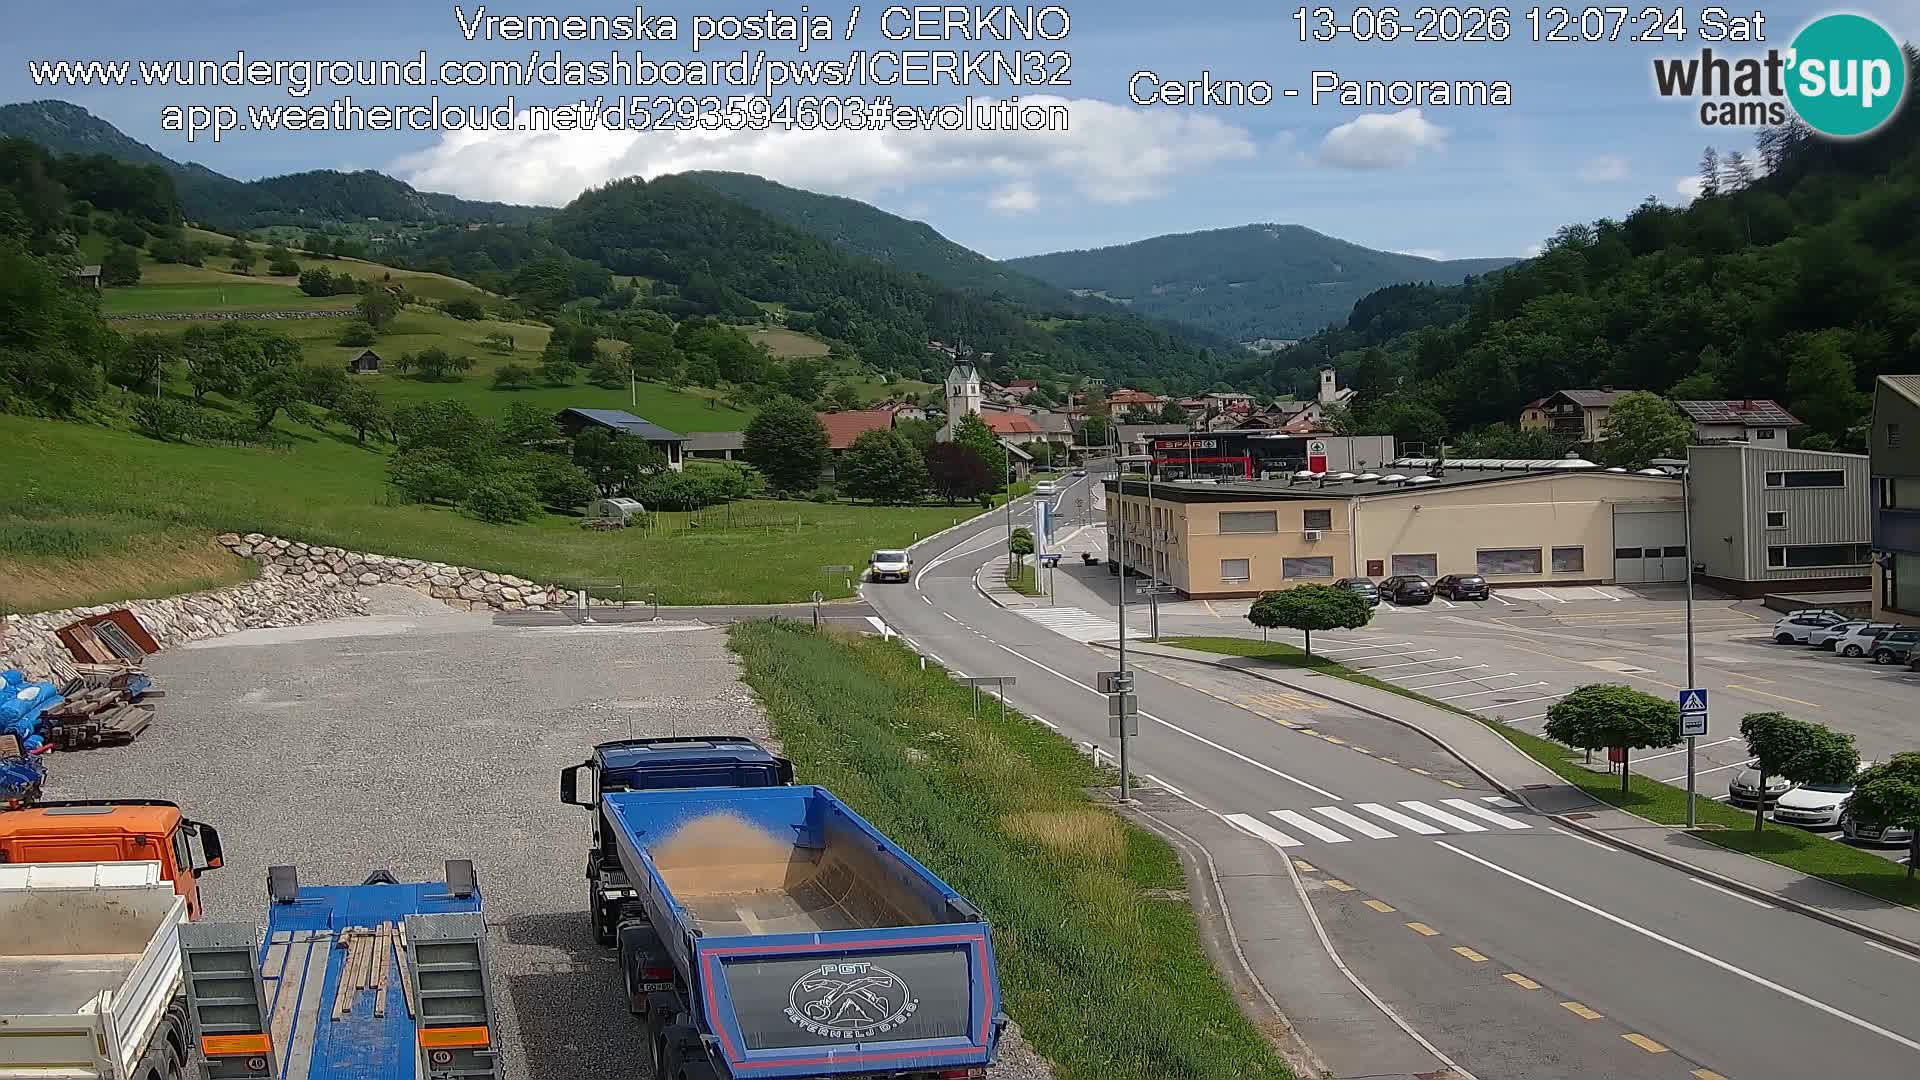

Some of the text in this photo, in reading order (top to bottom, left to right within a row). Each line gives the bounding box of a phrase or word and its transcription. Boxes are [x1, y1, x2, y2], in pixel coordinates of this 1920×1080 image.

[1166, 440, 1201, 449] SPAR
[820, 962, 871, 976] PGT
[783, 1007, 875, 1039] PETERNELJ
